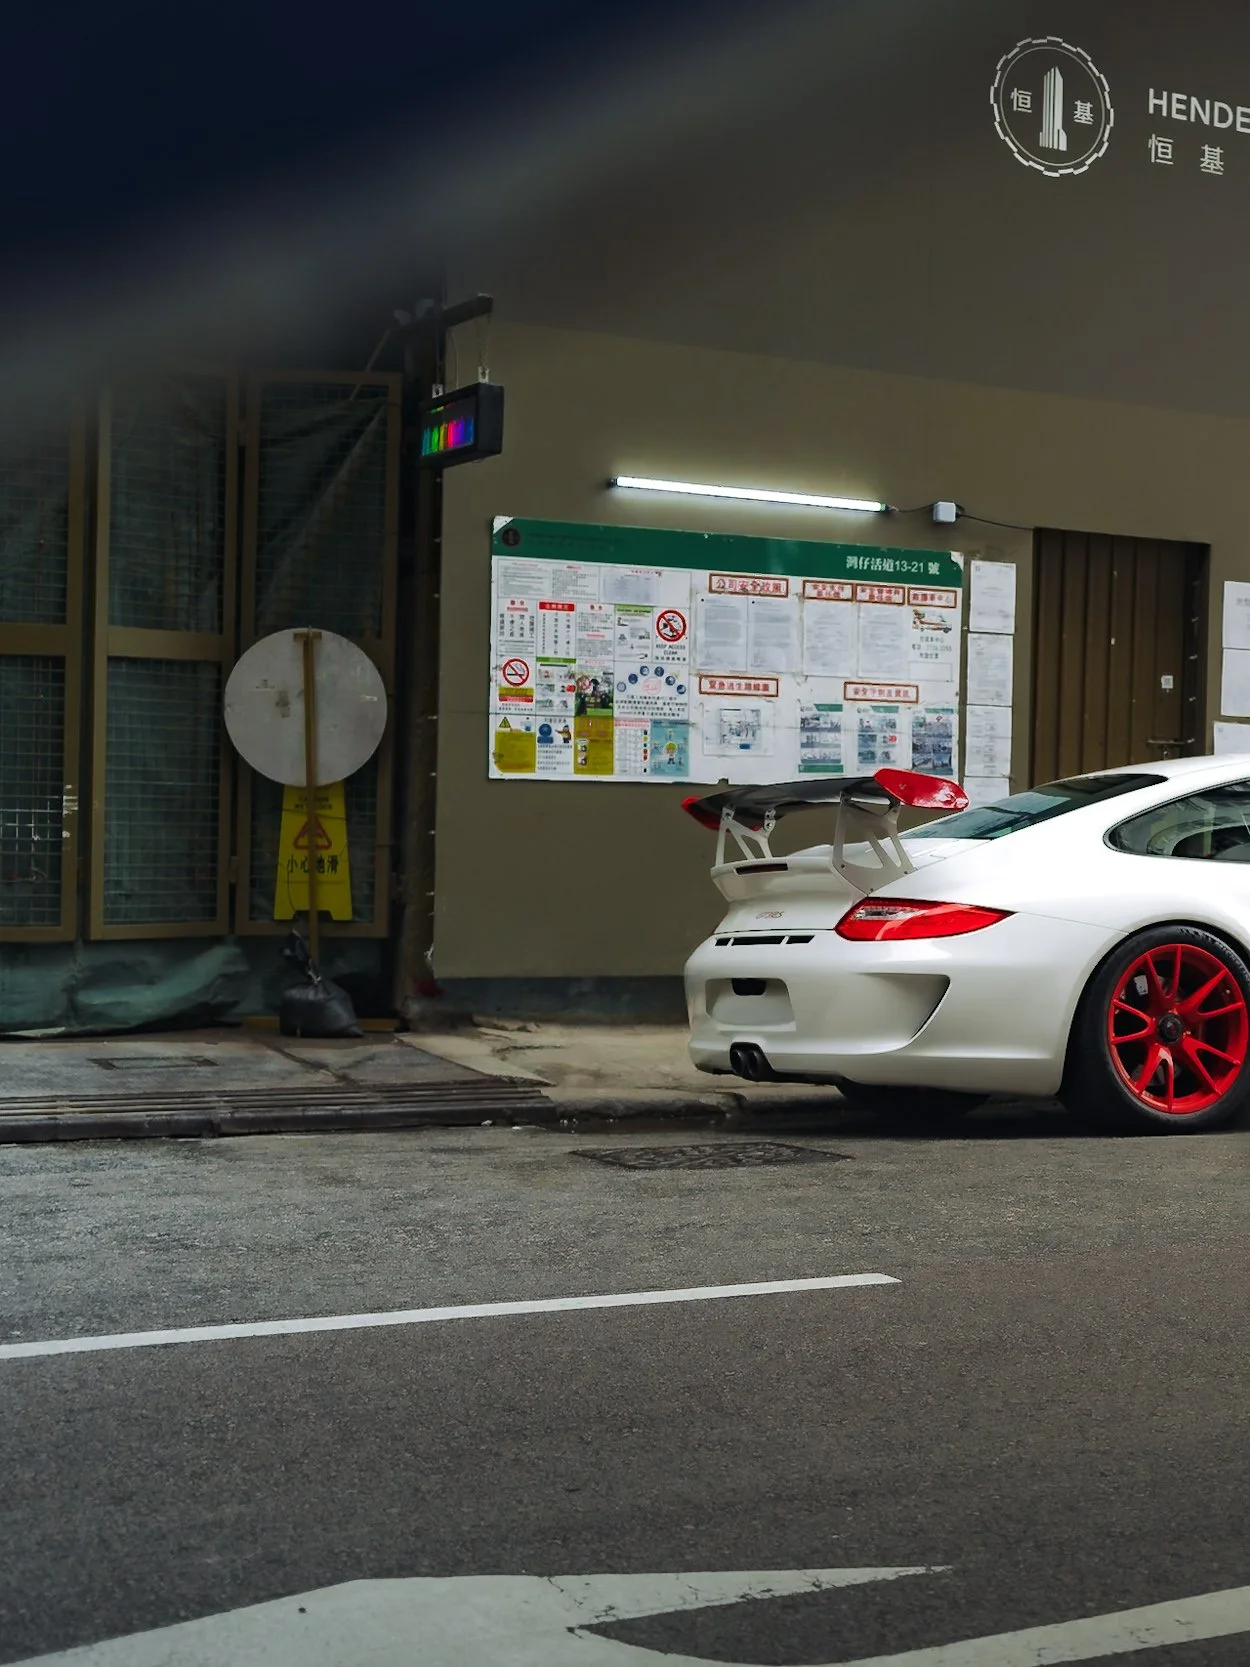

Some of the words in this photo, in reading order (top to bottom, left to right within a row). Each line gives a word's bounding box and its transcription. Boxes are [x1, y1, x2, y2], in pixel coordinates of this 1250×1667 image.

[1010, 87, 1032, 113] 恒
[1073, 100, 1094, 125] 基
[287, 854, 339, 874] 小心地滑
